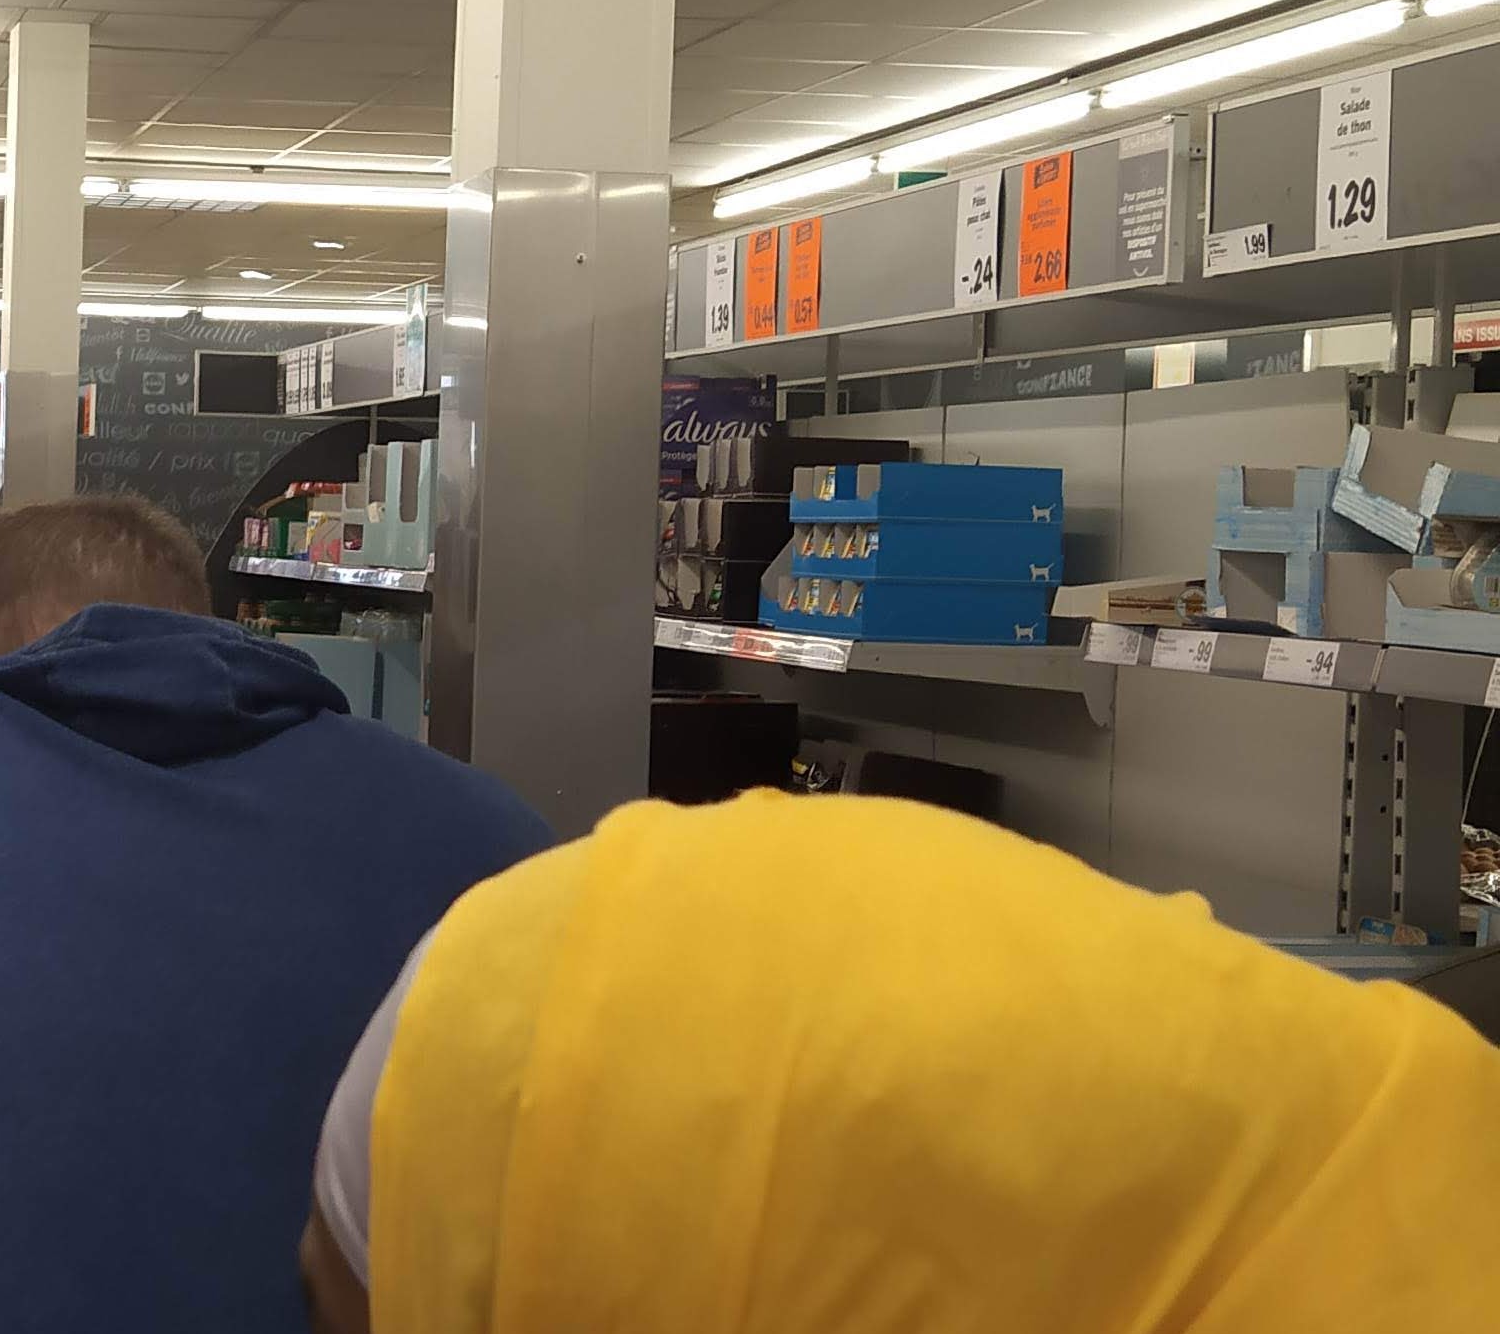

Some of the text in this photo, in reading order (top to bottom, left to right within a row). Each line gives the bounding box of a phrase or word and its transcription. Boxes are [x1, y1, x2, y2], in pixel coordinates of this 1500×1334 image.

[1340, 97, 1370, 115] Salade
[1337, 118, 1372, 137] de thon
[1328, 177, 1376, 229] 1.29
[1245, 233, 1266, 255] 1.99
[961, 255, 993, 295] -.24
[1033, 248, 1062, 284] 2.66
[711, 302, 729, 335] 1.39
[1189, 640, 1211, 663] -.99
[1306, 651, 1334, 674] -.94
